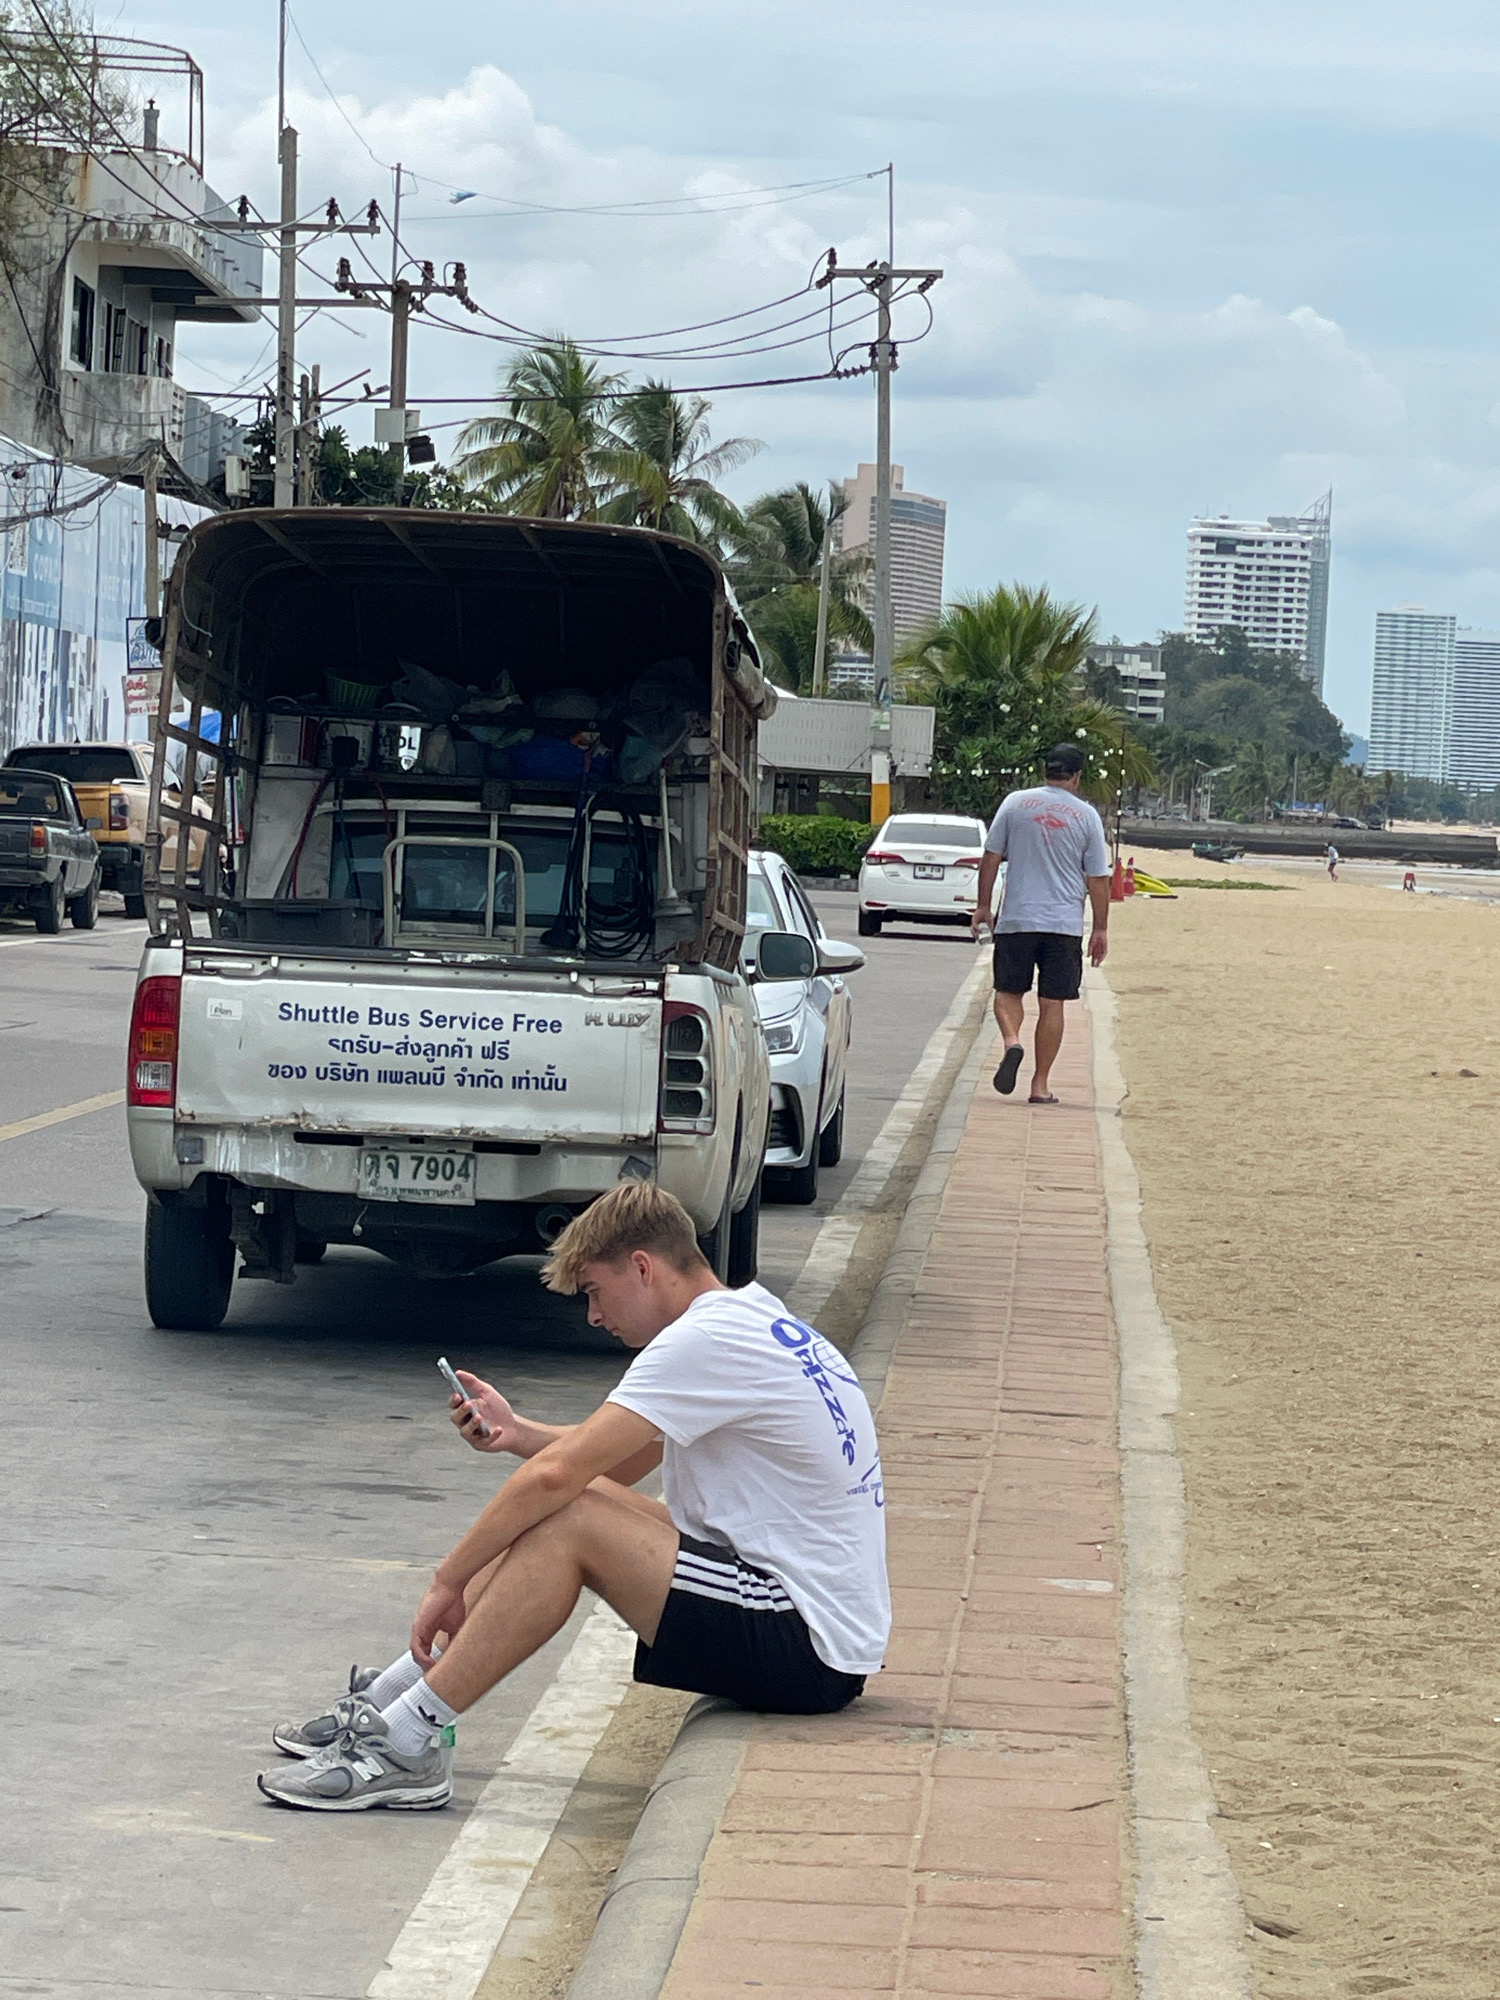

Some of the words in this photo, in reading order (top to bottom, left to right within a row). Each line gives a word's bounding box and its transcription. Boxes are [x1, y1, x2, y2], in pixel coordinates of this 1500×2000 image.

[278, 1002, 360, 1025] Shuttle
[368, 1006, 410, 1027] Bus
[419, 1009, 504, 1032] Service
[512, 1013, 563, 1034] Free
[481, 1039, 510, 1061] ฟรี
[268, 1063, 307, 1079] ของ
[315, 1062, 369, 1083] บริษัท
[377, 1065, 445, 1086] แพลนบี
[453, 1066, 503, 1089] จำกัด
[511, 1064, 567, 1092] เท่านั้น
[410, 1155, 475, 1183] 7904
